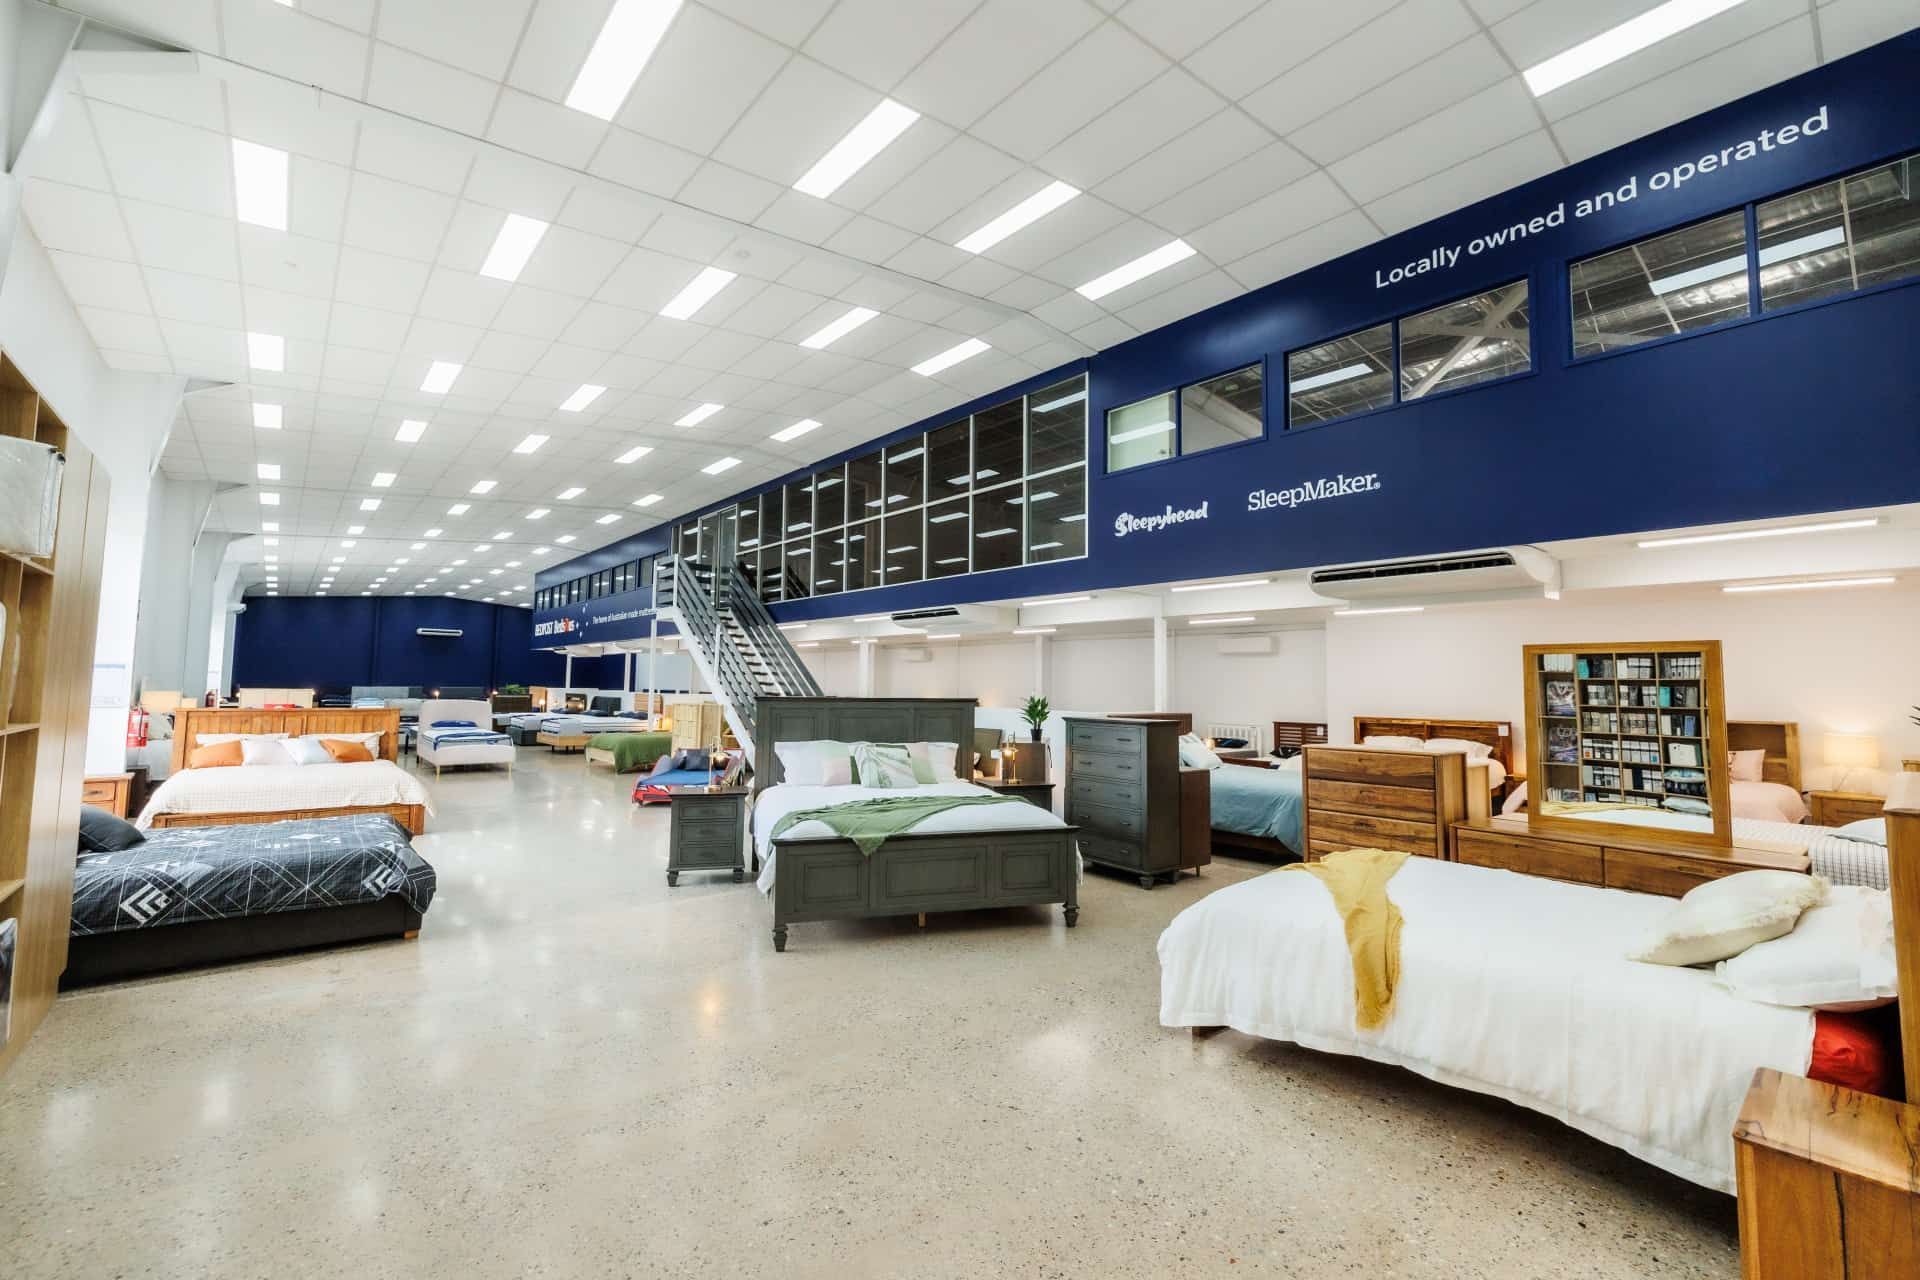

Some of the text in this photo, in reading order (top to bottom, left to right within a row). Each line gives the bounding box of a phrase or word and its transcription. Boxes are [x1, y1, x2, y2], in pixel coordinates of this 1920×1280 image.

[1375, 105, 1829, 288] Locally owned and operated
[1114, 501, 1208, 537] Sleepyhead
